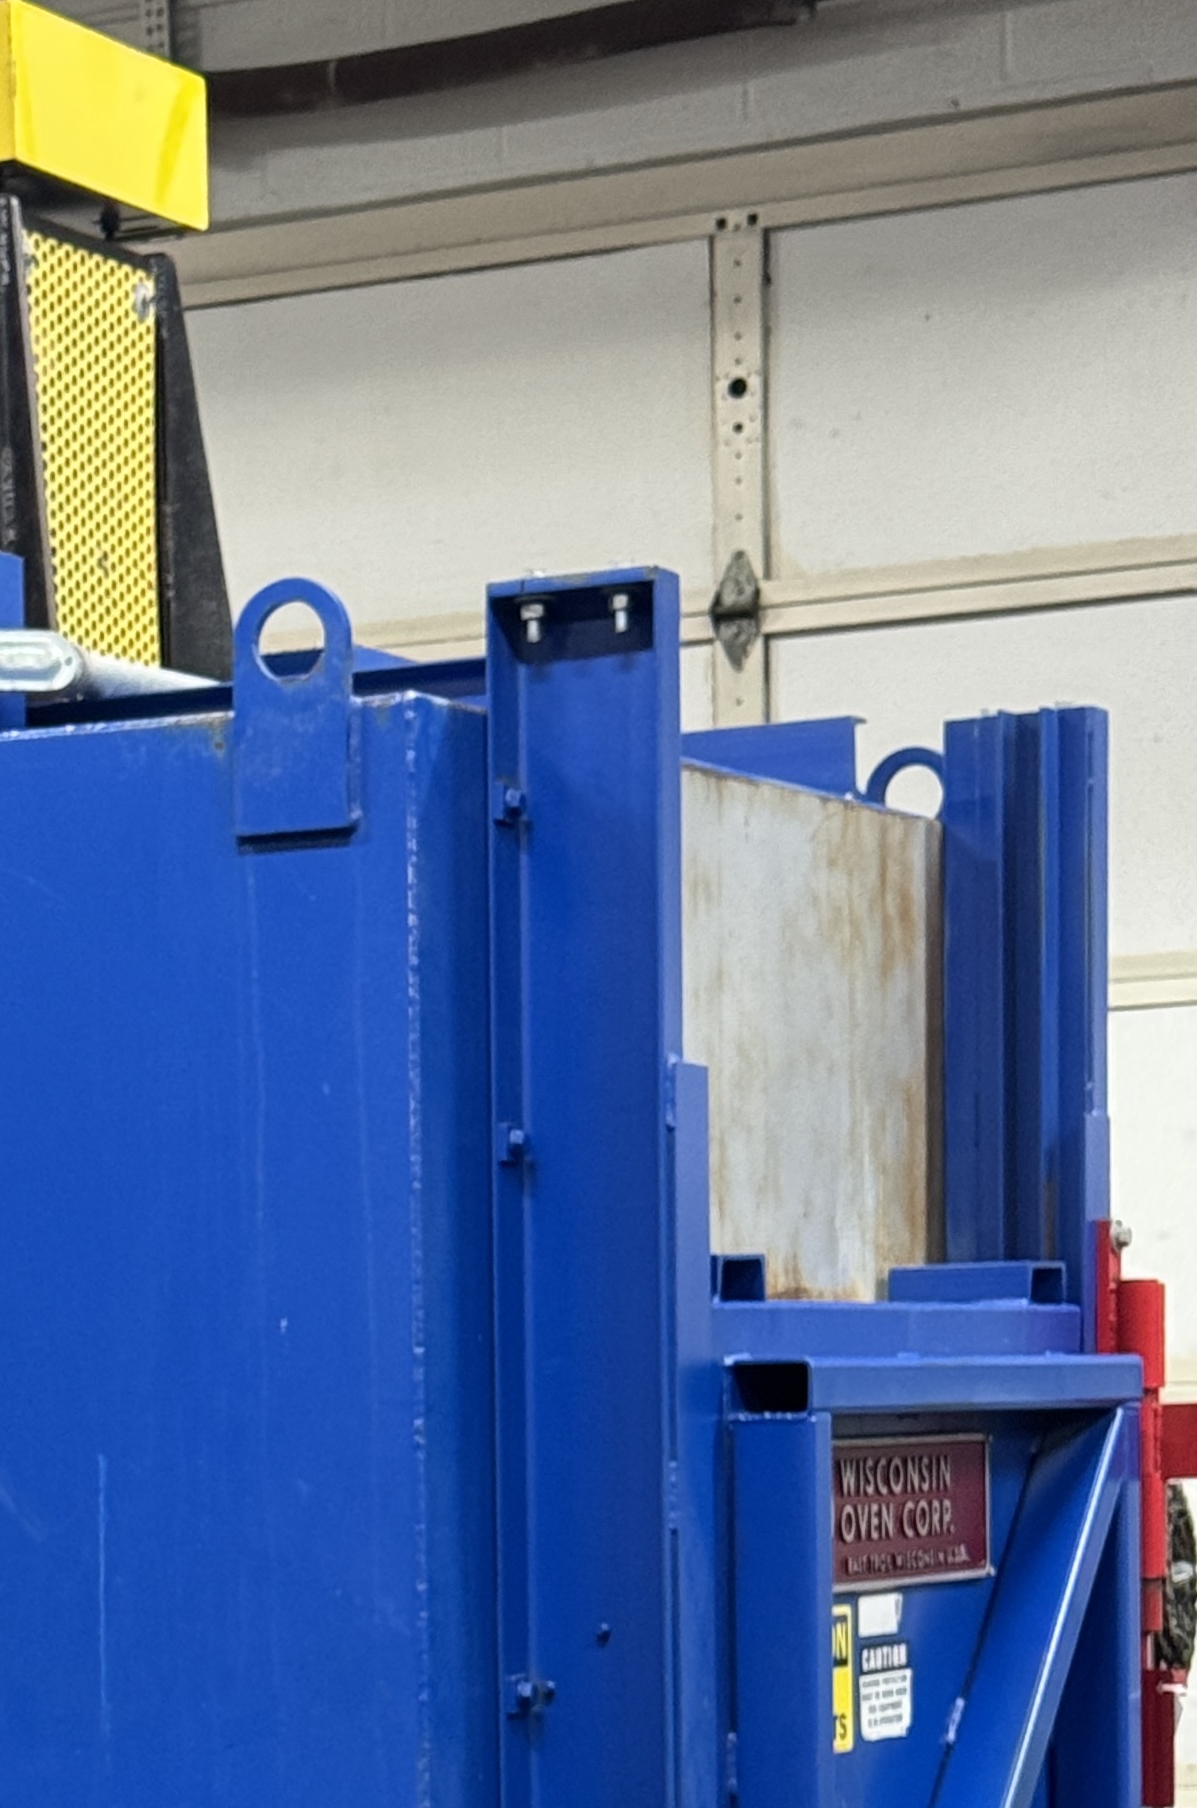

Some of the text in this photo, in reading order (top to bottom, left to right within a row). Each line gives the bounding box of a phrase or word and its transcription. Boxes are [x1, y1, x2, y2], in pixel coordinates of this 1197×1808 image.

[840, 1454, 952, 1497] WISCONSIN
[840, 1498, 955, 1544] OVEN CORP.
[861, 1642, 907, 1673] CAUTION
